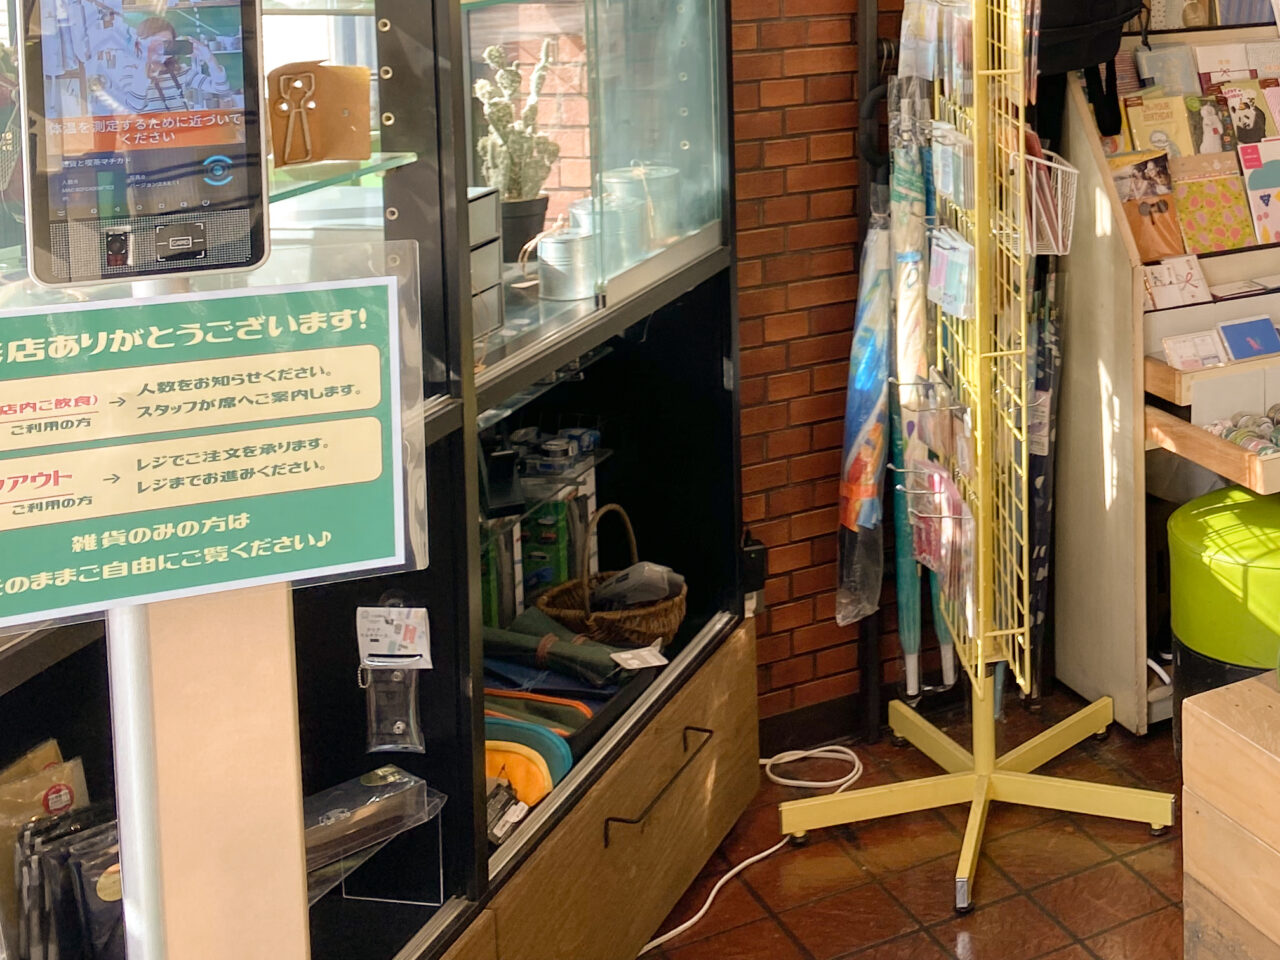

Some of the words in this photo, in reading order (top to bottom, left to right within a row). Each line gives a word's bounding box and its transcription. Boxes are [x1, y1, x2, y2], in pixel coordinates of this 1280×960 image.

[48, 113, 242, 135] 体温を測定するために近づいて
[121, 131, 176, 145] ください
[0, 307, 367, 363] 店ありがとうございます!
[137, 366, 332, 396] 人数をお知らせください。
[137, 384, 361, 418] スタッフが席へご案内します。
[11, 417, 91, 435] ご利用の方
[137, 437, 329, 471] レジでご注文を承ります。
[137, 459, 326, 494] レジまでお進みください。
[12, 496, 93, 515] ご利用の方
[71, 512, 250, 552] 雑貨のみの方は
